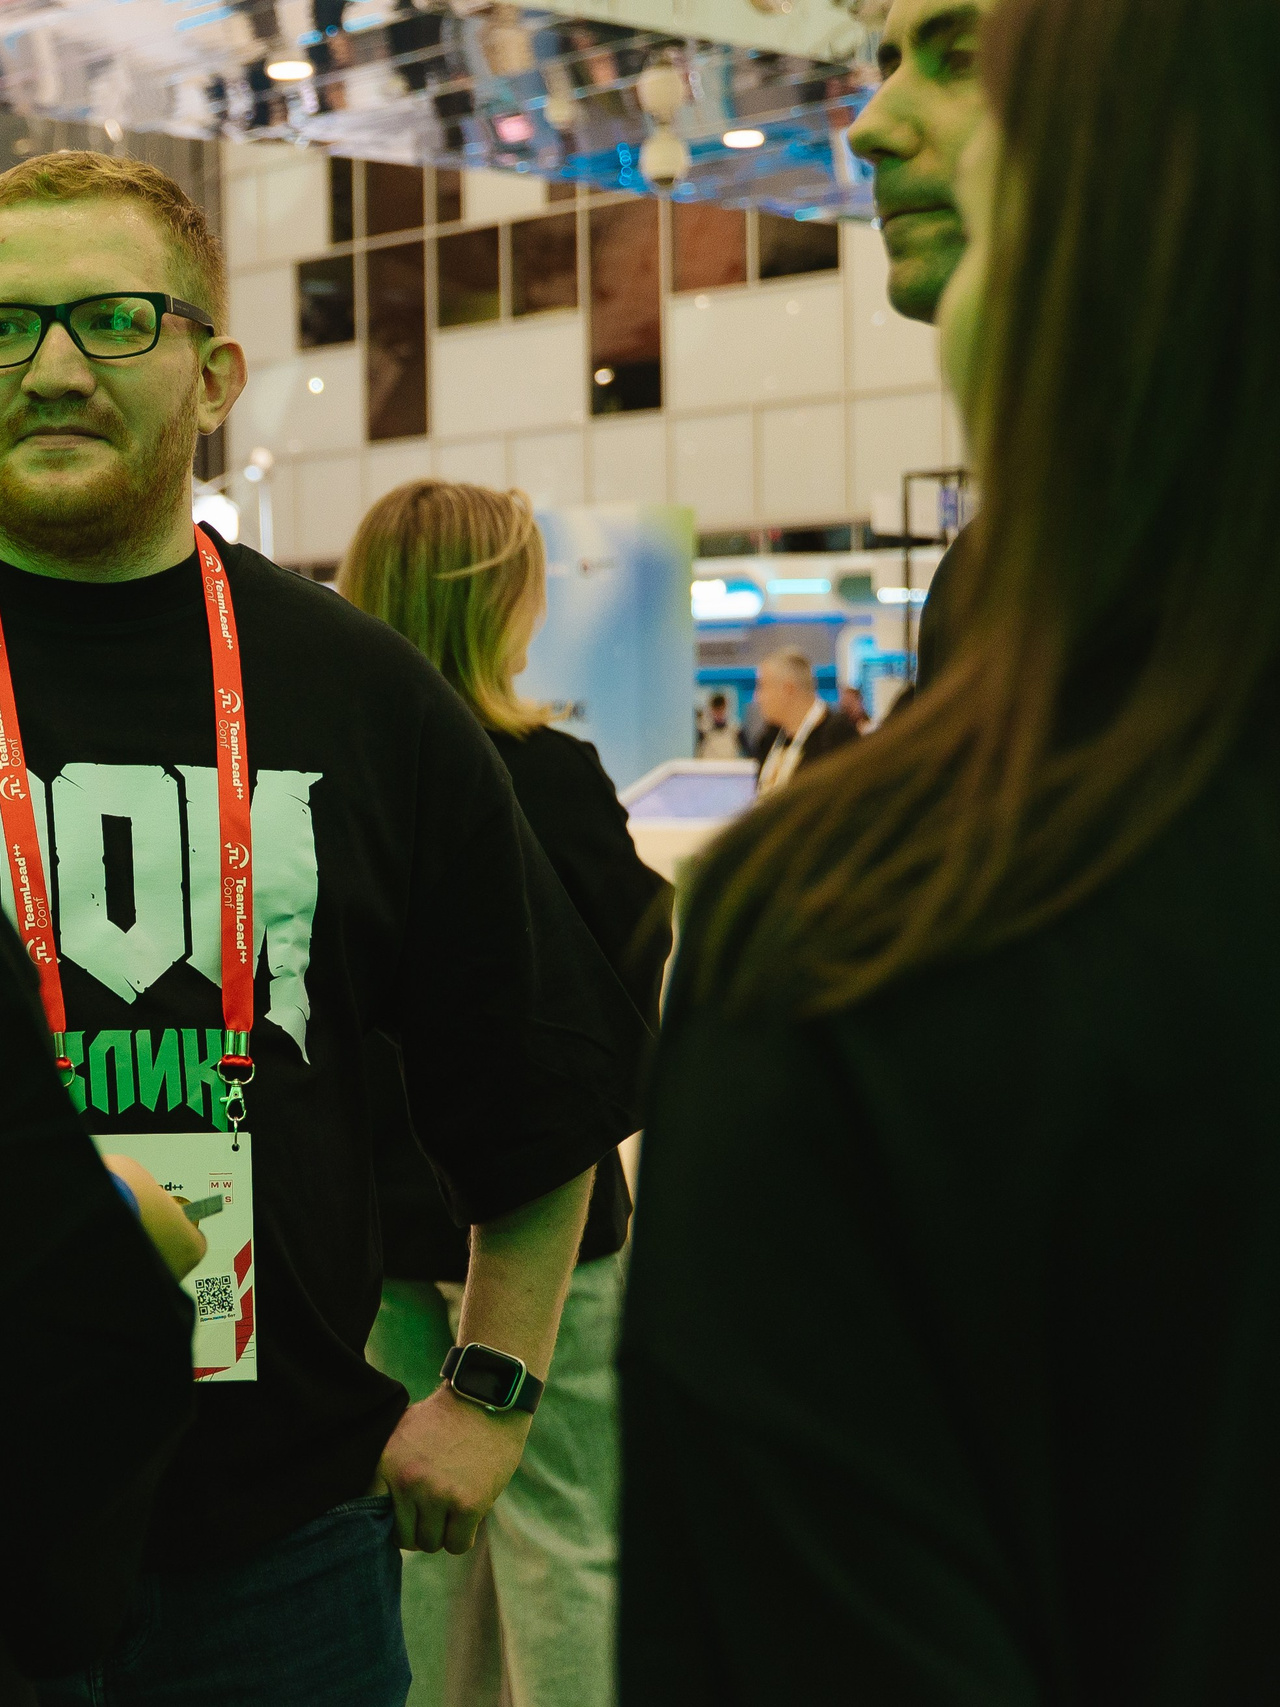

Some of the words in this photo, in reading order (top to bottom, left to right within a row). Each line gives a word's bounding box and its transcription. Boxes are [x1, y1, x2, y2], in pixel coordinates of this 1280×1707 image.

[205, 576, 217, 604] Conf
[215, 579, 234, 650] TeamLead++
[218, 719, 230, 750] Conf
[7, 738, 22, 767] Conf
[229, 720, 244, 801] TeamLead++
[12, 843, 36, 931] TeamLead++
[223, 876, 236, 909] Conf
[33, 896, 48, 929] Conf
[235, 876, 247, 964] TeamLead++
